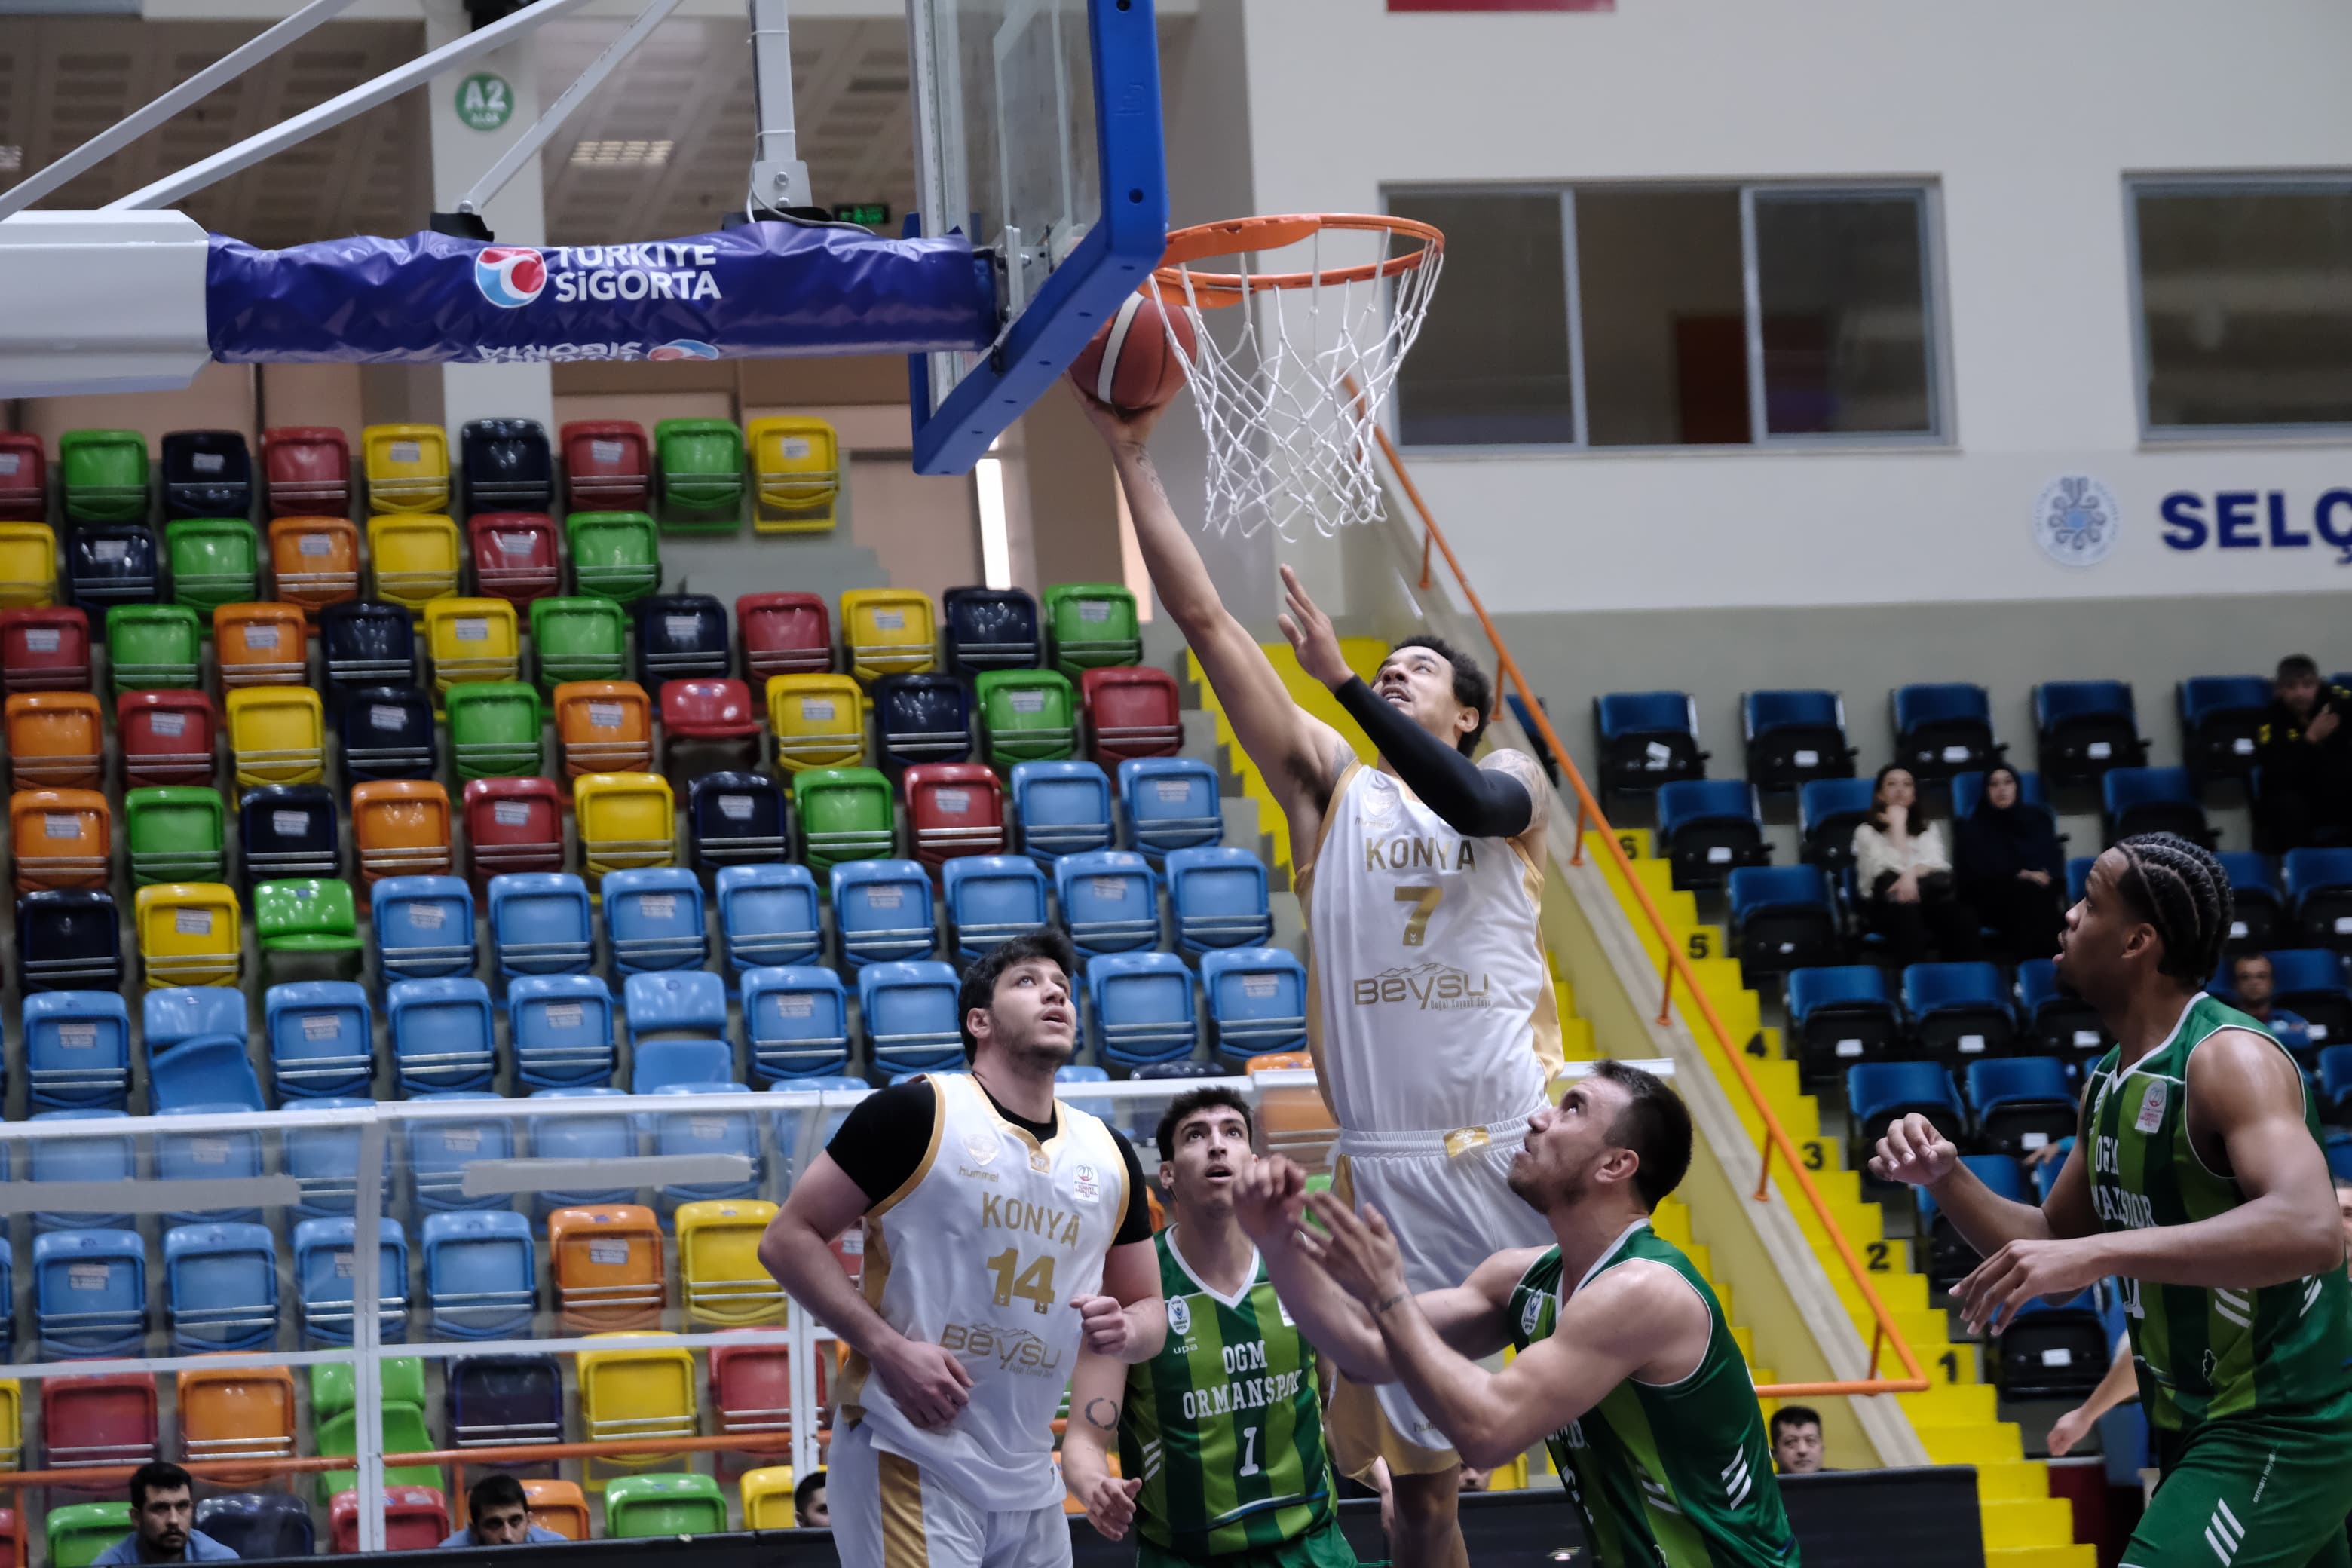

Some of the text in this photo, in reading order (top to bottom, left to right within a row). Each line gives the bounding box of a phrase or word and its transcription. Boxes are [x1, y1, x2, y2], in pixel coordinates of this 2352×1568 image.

[465, 80, 506, 109] A2
[1365, 837, 1476, 872] KONYA
[1620, 836, 1637, 859] 6
[1394, 886, 1443, 945] 7
[1689, 933, 1709, 960] 5
[1745, 1030, 1767, 1058] 4
[1802, 1141, 1825, 1171] 3
[958, 1165, 1000, 1183] hummel
[982, 1191, 1081, 1251] KONYA
[1866, 1241, 1891, 1271] 2
[987, 1247, 1055, 1315] 14
[1173, 1343, 1199, 1355] upa
[1221, 1340, 1268, 1374] OGM
[1939, 1350, 1958, 1383] 1
[1182, 1369, 1303, 1420] ORMANSPOR
[1240, 1426, 1260, 1477] 1
